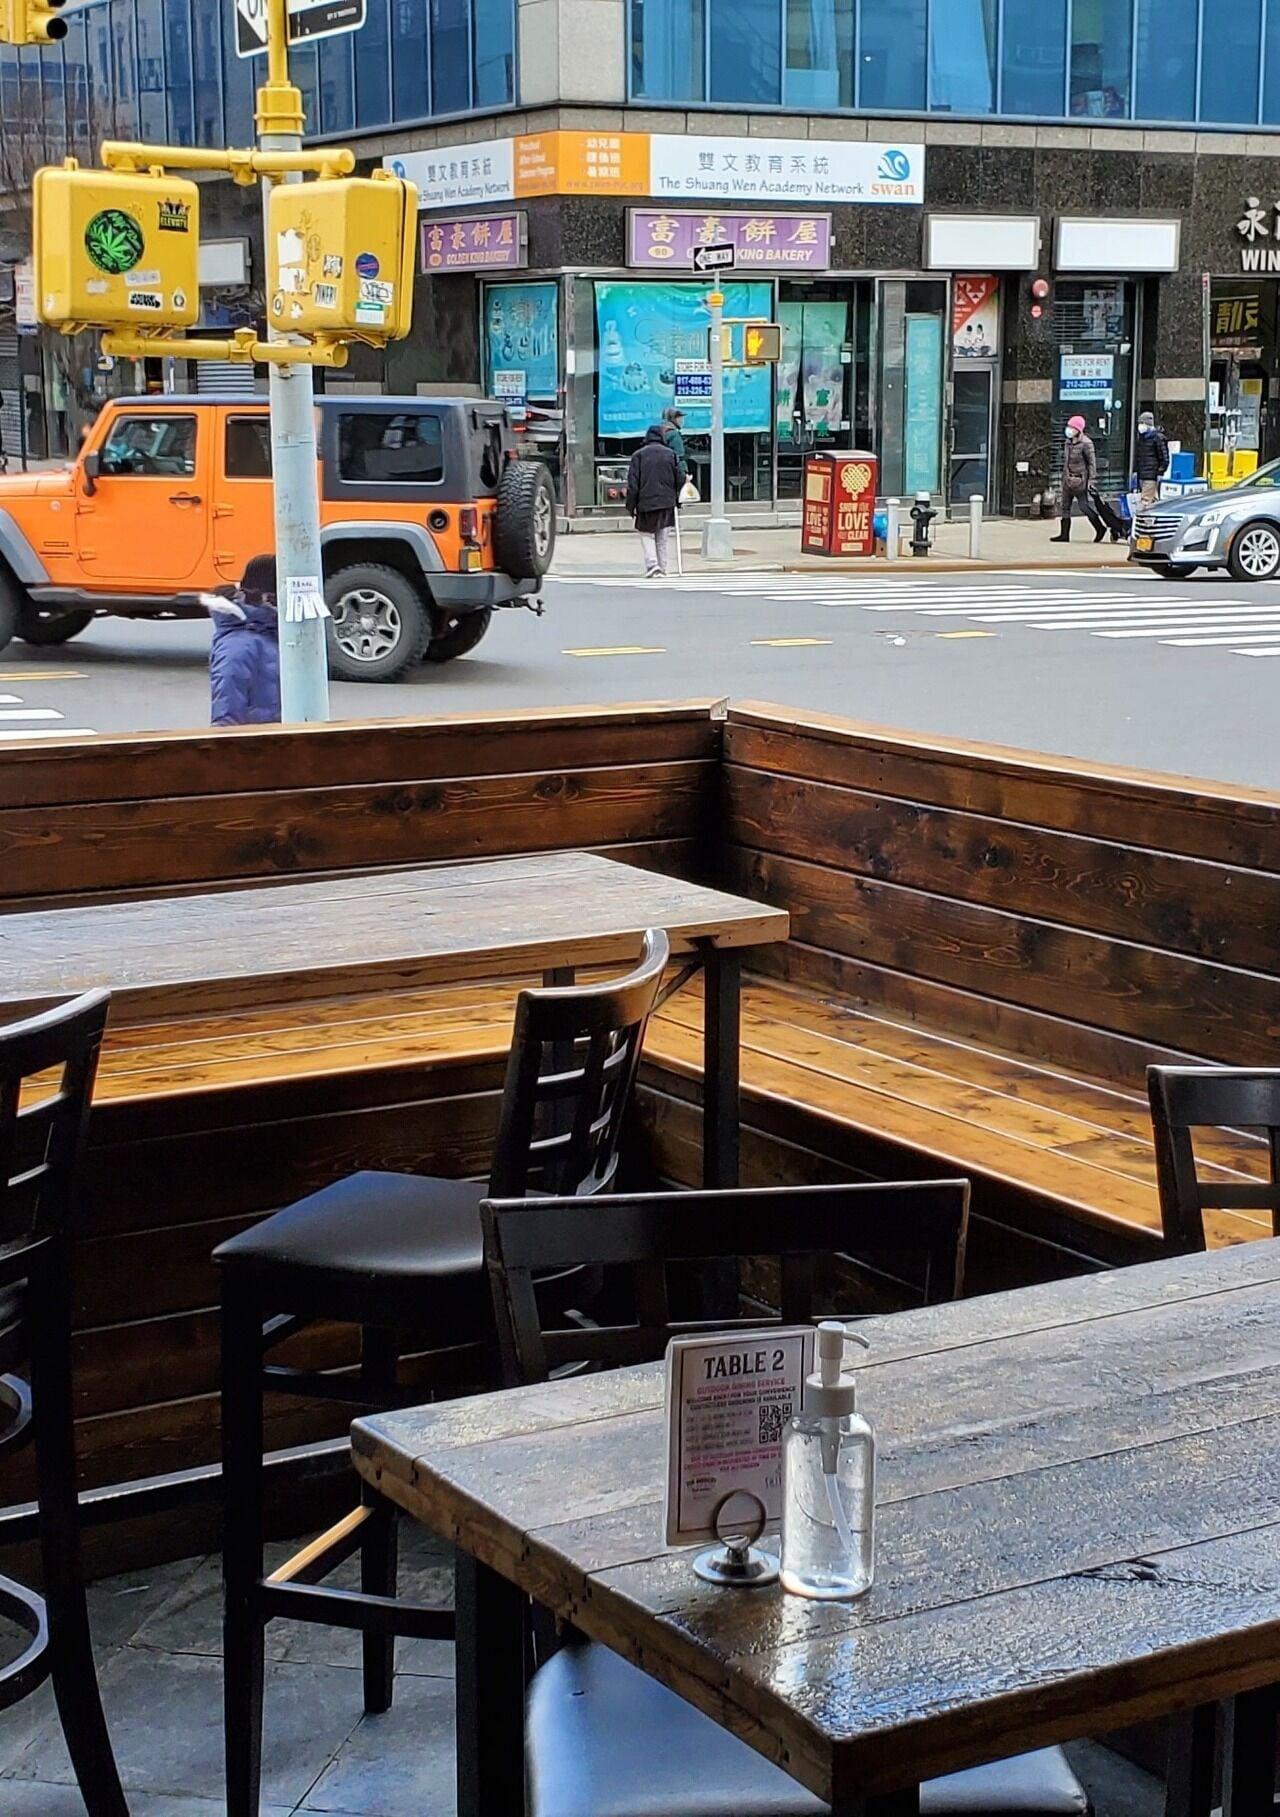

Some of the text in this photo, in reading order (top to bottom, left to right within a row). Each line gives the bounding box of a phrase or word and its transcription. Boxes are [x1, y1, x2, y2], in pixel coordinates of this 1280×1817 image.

[698, 152, 830, 176] 雙文教育系統
[485, 181, 510, 196] Network
[659, 177, 864, 196] The Shuang Wen Academy Network
[871, 183, 915, 196] swan
[428, 219, 513, 251] 富豪餅屋
[648, 216, 819, 245] 富豪餅屋
[700, 251, 712, 264] ONE
[716, 250, 730, 263] WAY
[736, 249, 813, 261] KING BAKERY
[1241, 250, 1280, 271] WIN
[806, 513, 822, 526] LOVE
[838, 512, 869, 530] LOVE
[703, 1349, 785, 1380] TABLE 2
[697, 1383, 731, 1396] OUTDOOR
[757, 1377, 786, 1388] SERVICE
